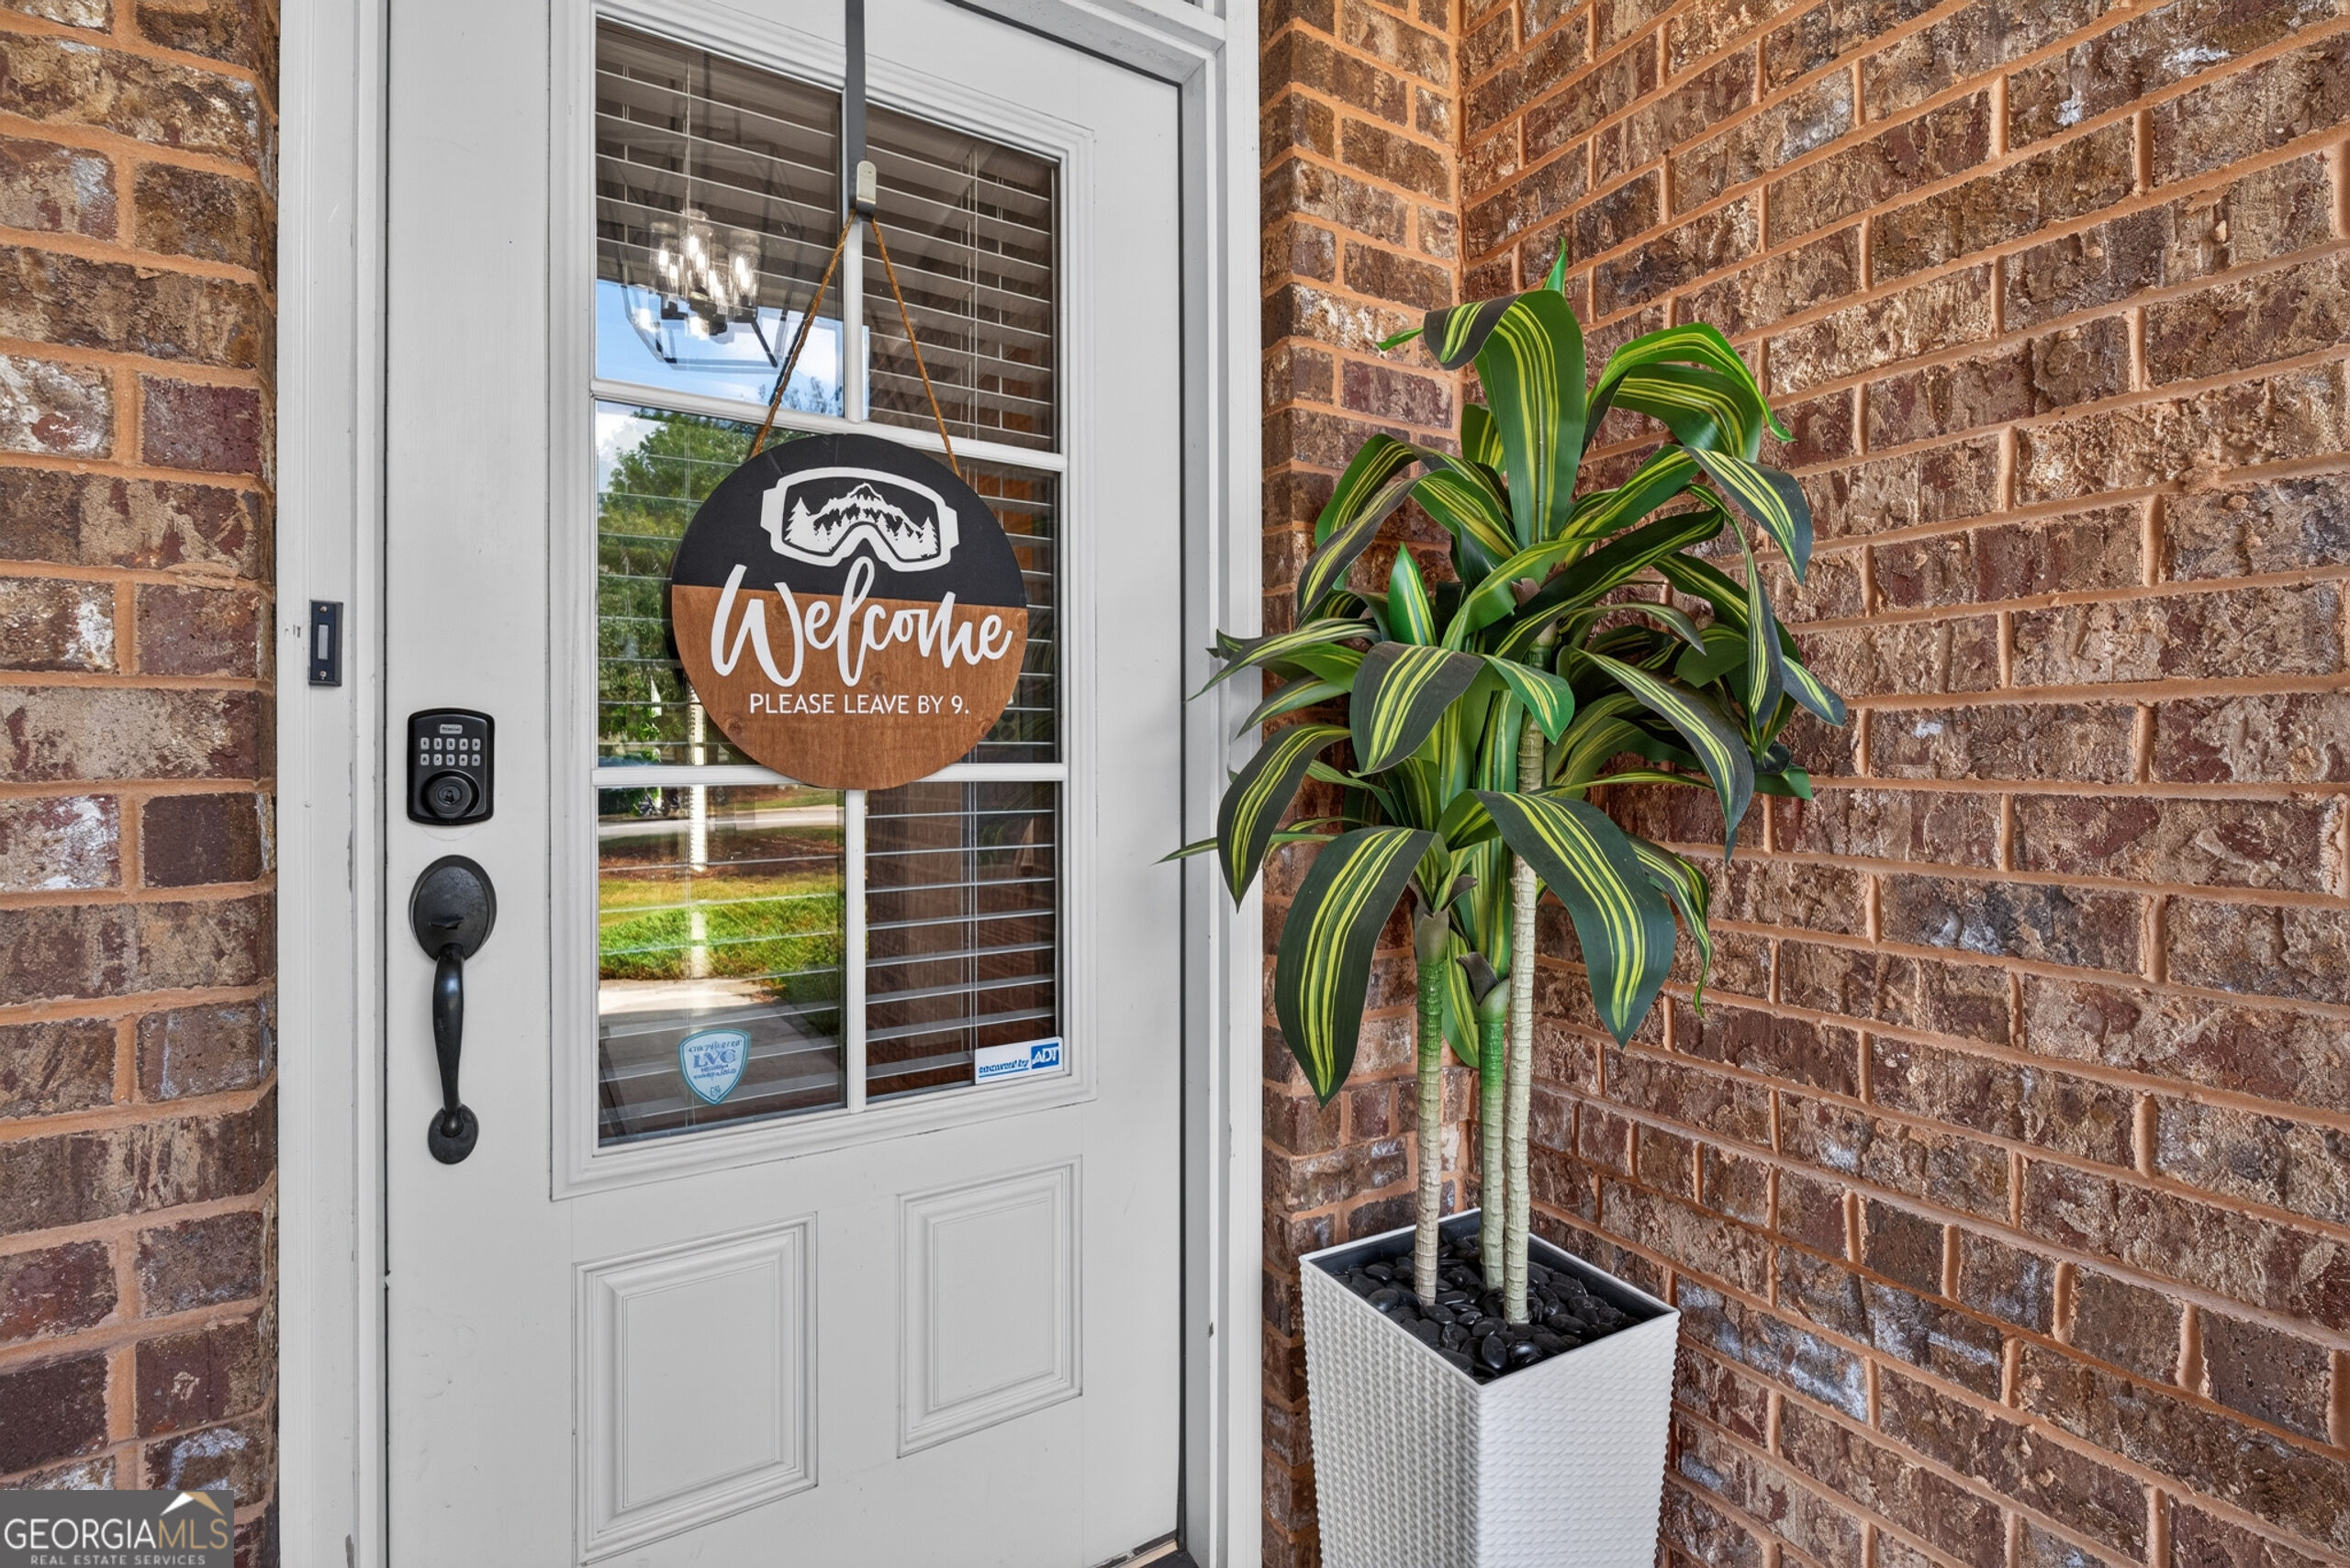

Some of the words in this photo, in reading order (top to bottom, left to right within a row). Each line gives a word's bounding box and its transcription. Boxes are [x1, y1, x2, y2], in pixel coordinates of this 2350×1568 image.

[711, 555, 1013, 688] Welcome
[749, 693, 835, 714] PLEASE
[844, 694, 911, 714] LEAVE
[917, 695, 944, 714] BY
[951, 695, 970, 714] 9.
[1032, 1047, 1058, 1065] ADT
